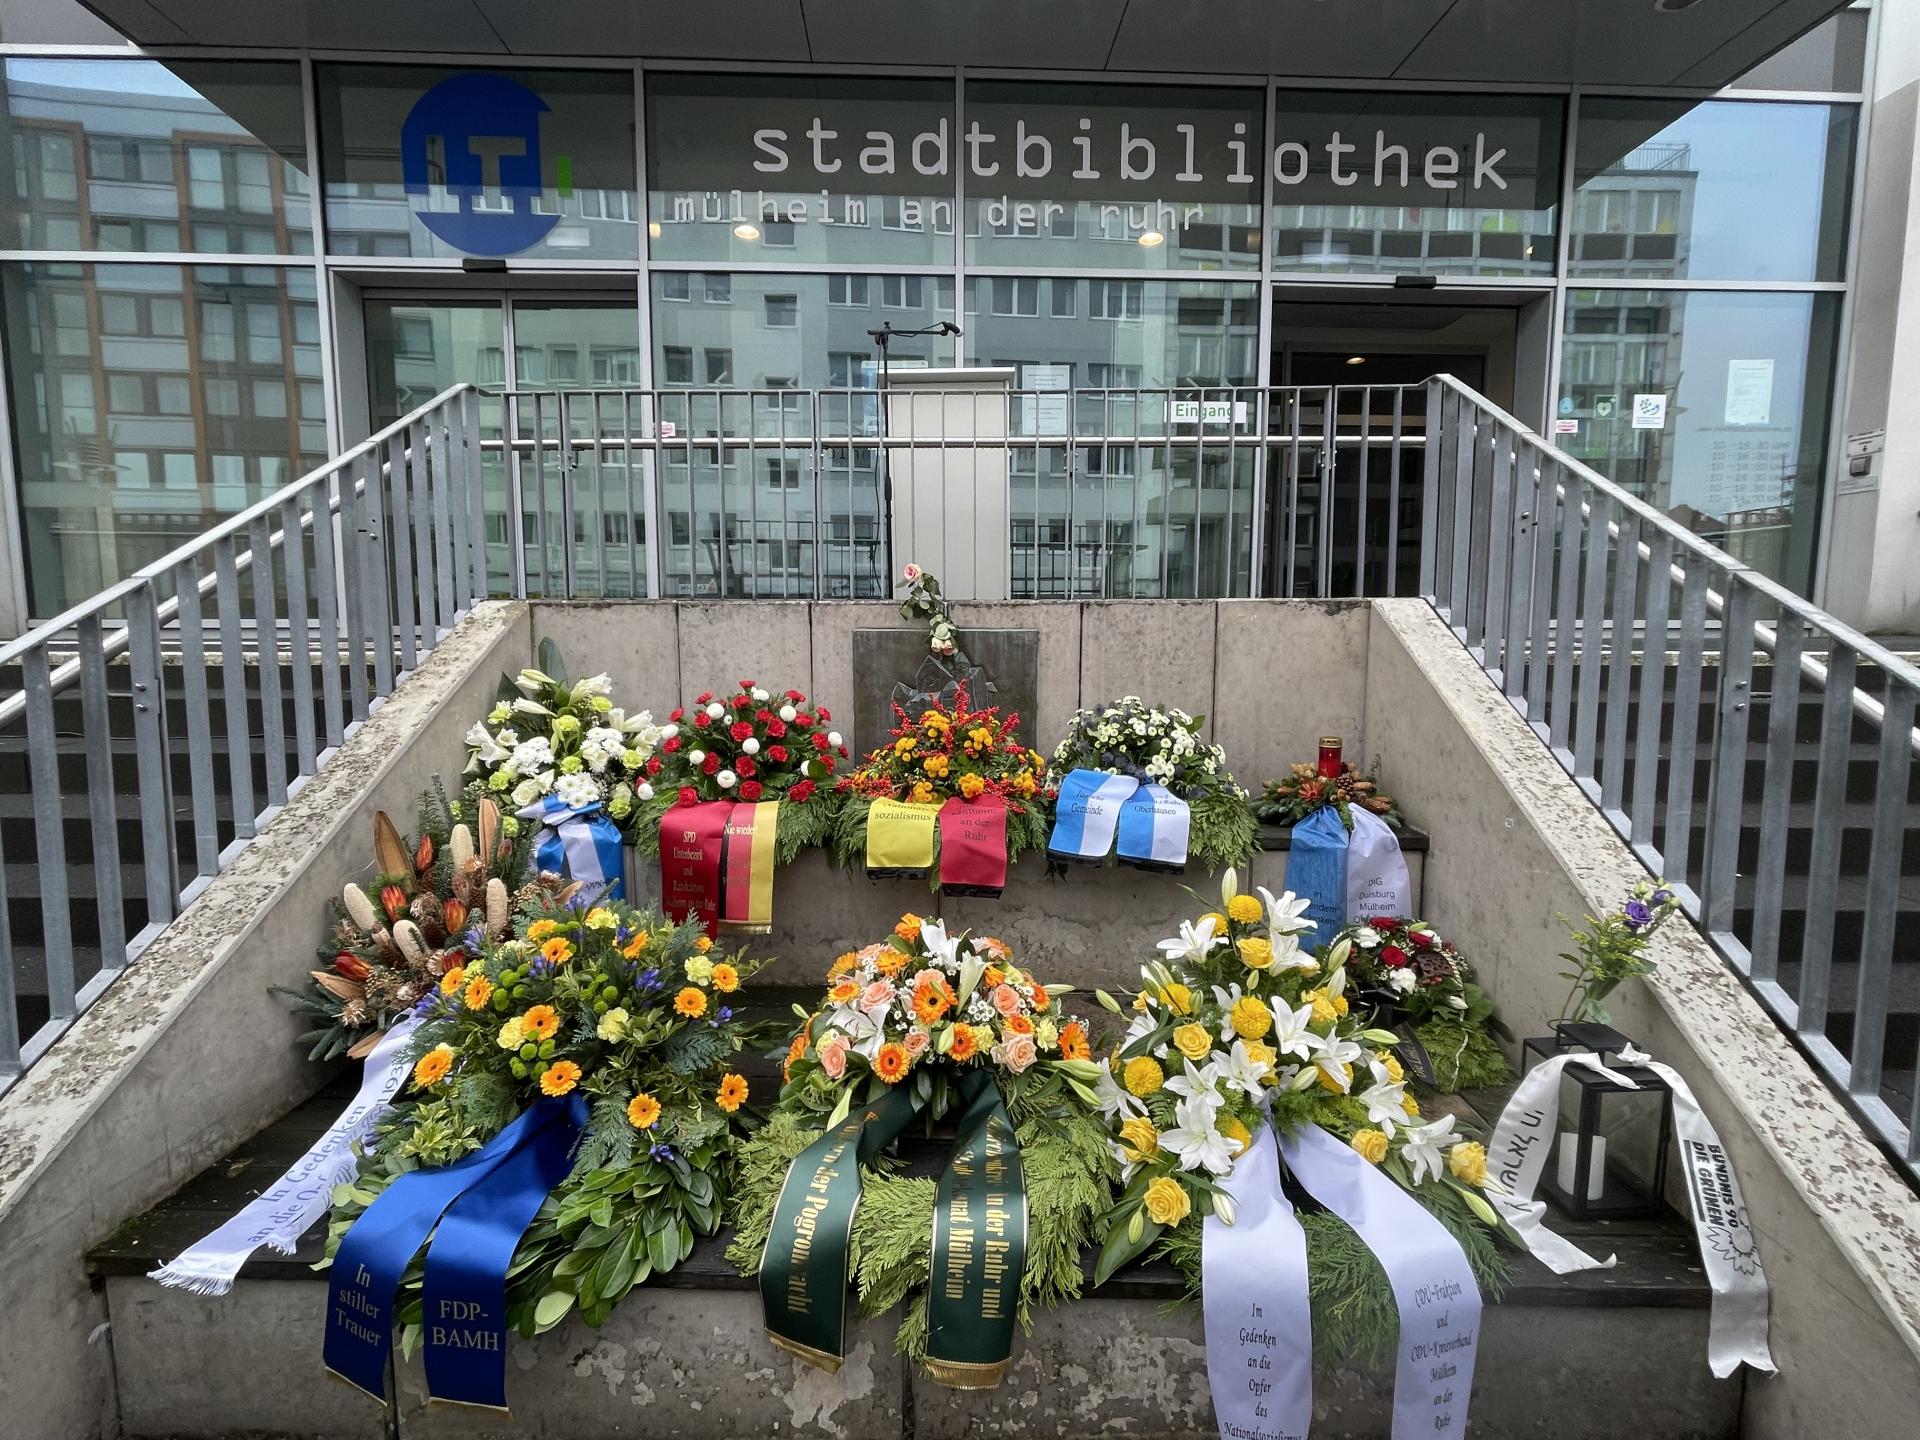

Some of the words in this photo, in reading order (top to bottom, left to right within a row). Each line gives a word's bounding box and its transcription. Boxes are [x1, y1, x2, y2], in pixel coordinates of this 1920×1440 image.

[752, 116, 1509, 190] stadtbibliothek
[674, 188, 866, 224] mülheim
[904, 198, 951, 226] an
[986, 194, 1064, 229] der
[1100, 197, 1204, 231] ruhr
[874, 812, 931, 821] sozialismus
[1071, 802, 1104, 816] Gemeinde
[1134, 805, 1177, 815] Oberhausen
[683, 831, 696, 843] SPD
[964, 830, 987, 841] Ruhr
[1359, 890, 1396, 900] Duisburg
[286, 1104, 367, 1183] Gedenken
[1691, 1140, 1710, 1164] DIE
[810, 1165, 840, 1193] der
[1698, 1167, 1725, 1227] GRÜNEN
[248, 1223, 275, 1243] an
[274, 1201, 303, 1226] die
[984, 1209, 1011, 1237] der
[1724, 1209, 1740, 1229] 90
[787, 1193, 829, 1315] Pogromacht
[945, 1228, 975, 1300] Mülheim
[983, 1240, 1010, 1283] Ruhr
[355, 1263, 371, 1288] In
[339, 1288, 381, 1320] stiller
[981, 1288, 1005, 1319] und
[1414, 1279, 1462, 1308] CDU-Fraktion
[439, 1299, 489, 1321] FDP-
[1251, 1302, 1263, 1318] Im
[1436, 1309, 1449, 1329] und
[335, 1307, 382, 1347] Trauer
[431, 1326, 499, 1352] BAMH
[1239, 1327, 1277, 1349] Gedenken
[1247, 1357, 1258, 1368] an
[1259, 1354, 1271, 1370] die
[1248, 1378, 1272, 1397] Opfer
[1254, 1401, 1268, 1418] des
